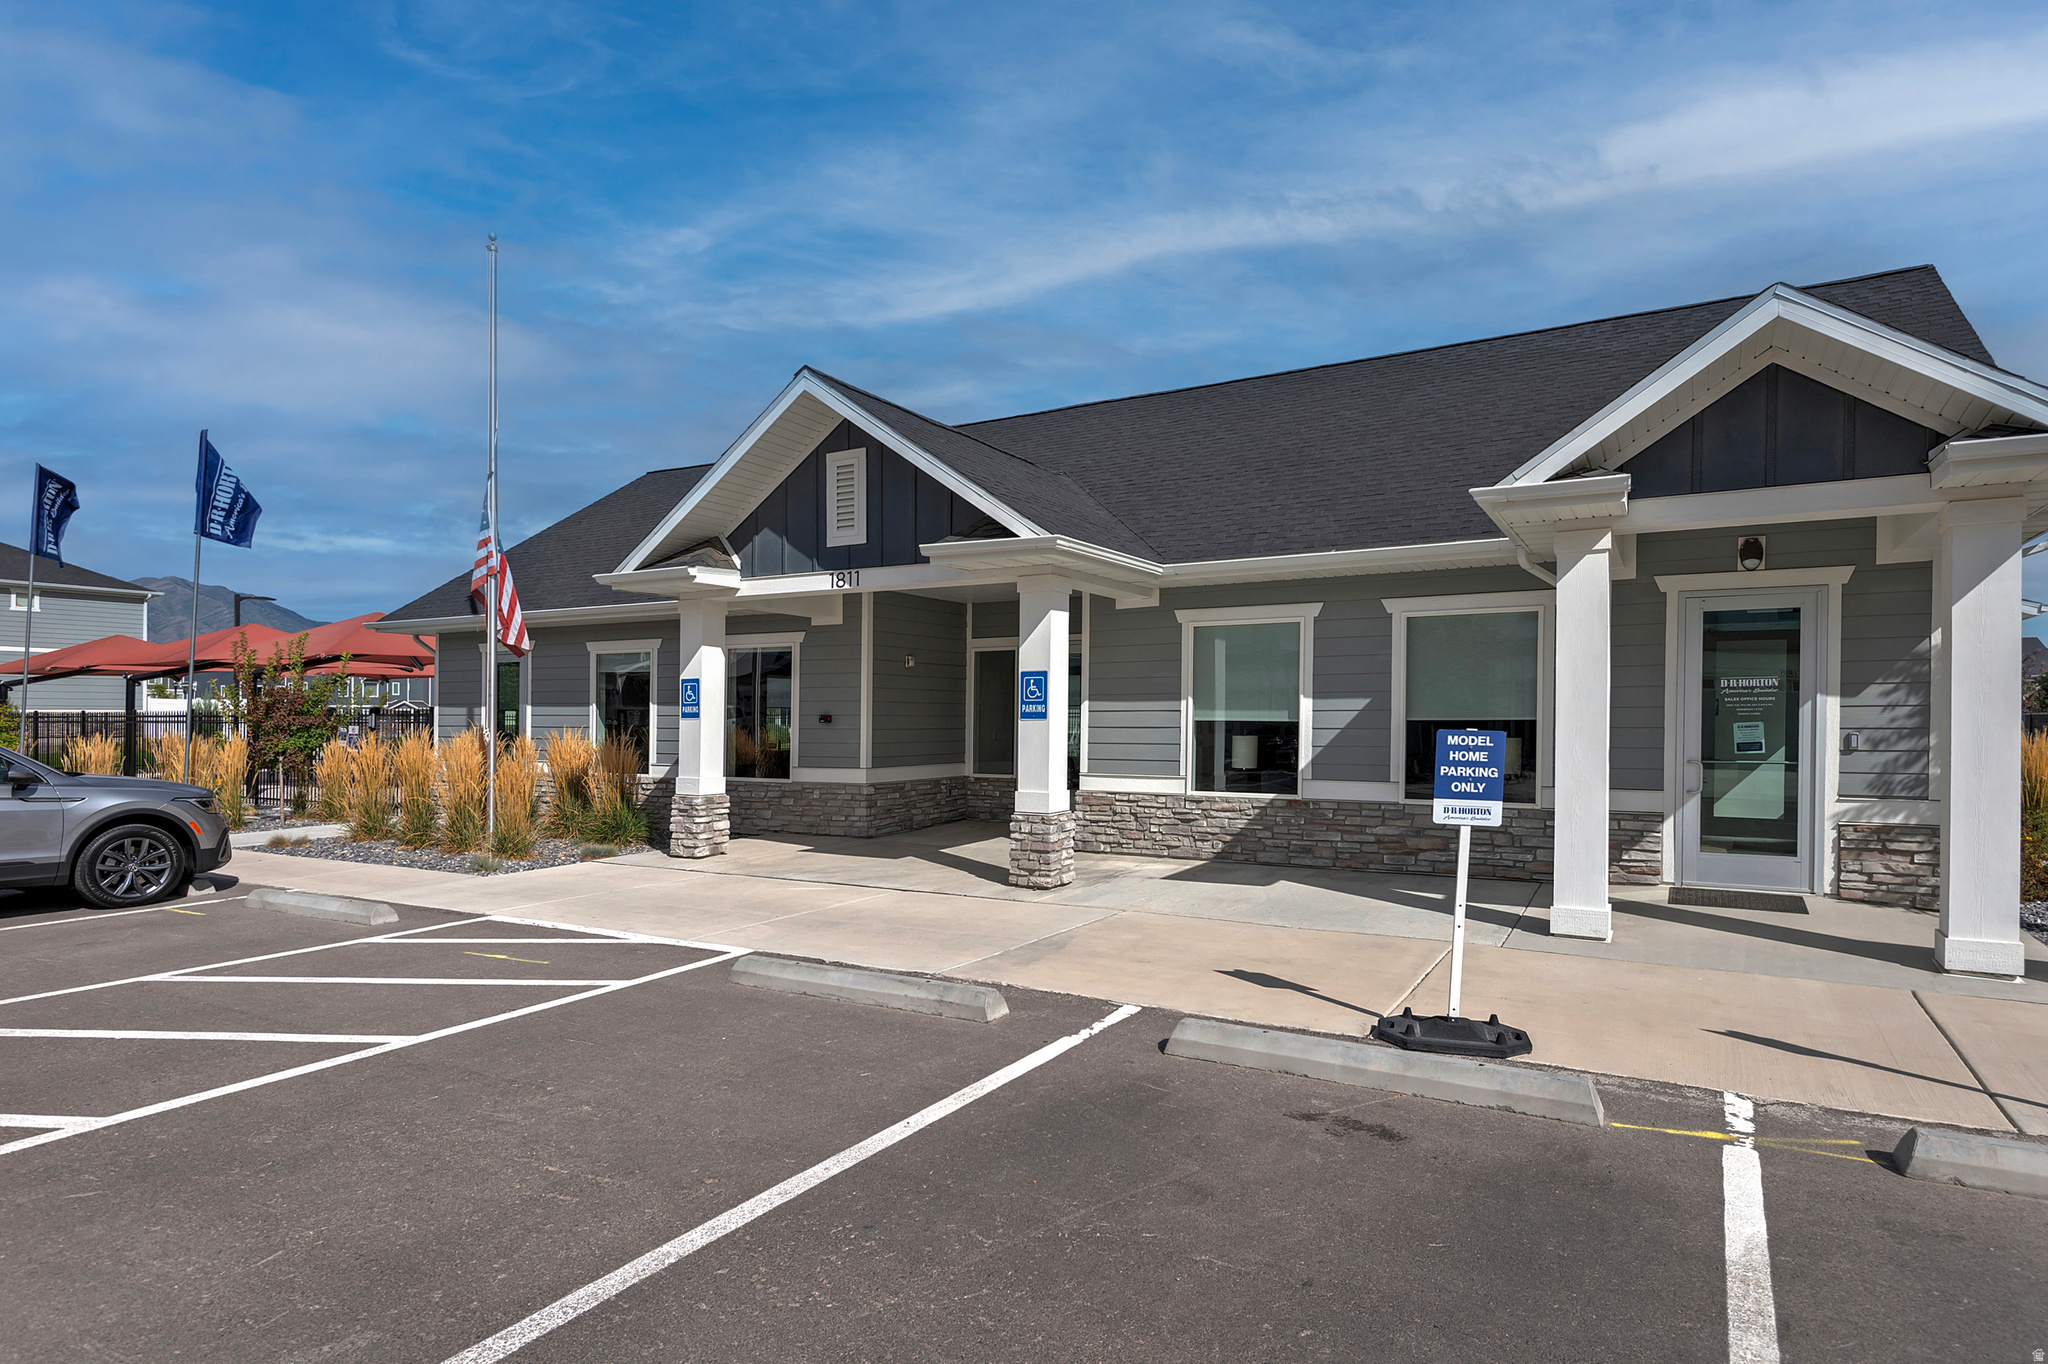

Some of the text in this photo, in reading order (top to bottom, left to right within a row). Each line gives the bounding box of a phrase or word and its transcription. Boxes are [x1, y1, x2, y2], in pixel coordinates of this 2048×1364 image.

[224, 492, 246, 539] America's
[829, 570, 860, 589] 1811
[1022, 704, 1046, 713] PARKING
[1447, 735, 1494, 746] MODEL
[1449, 751, 1489, 762] HOME
[1440, 766, 1499, 778] PARKING
[1451, 782, 1486, 793] ONLY
